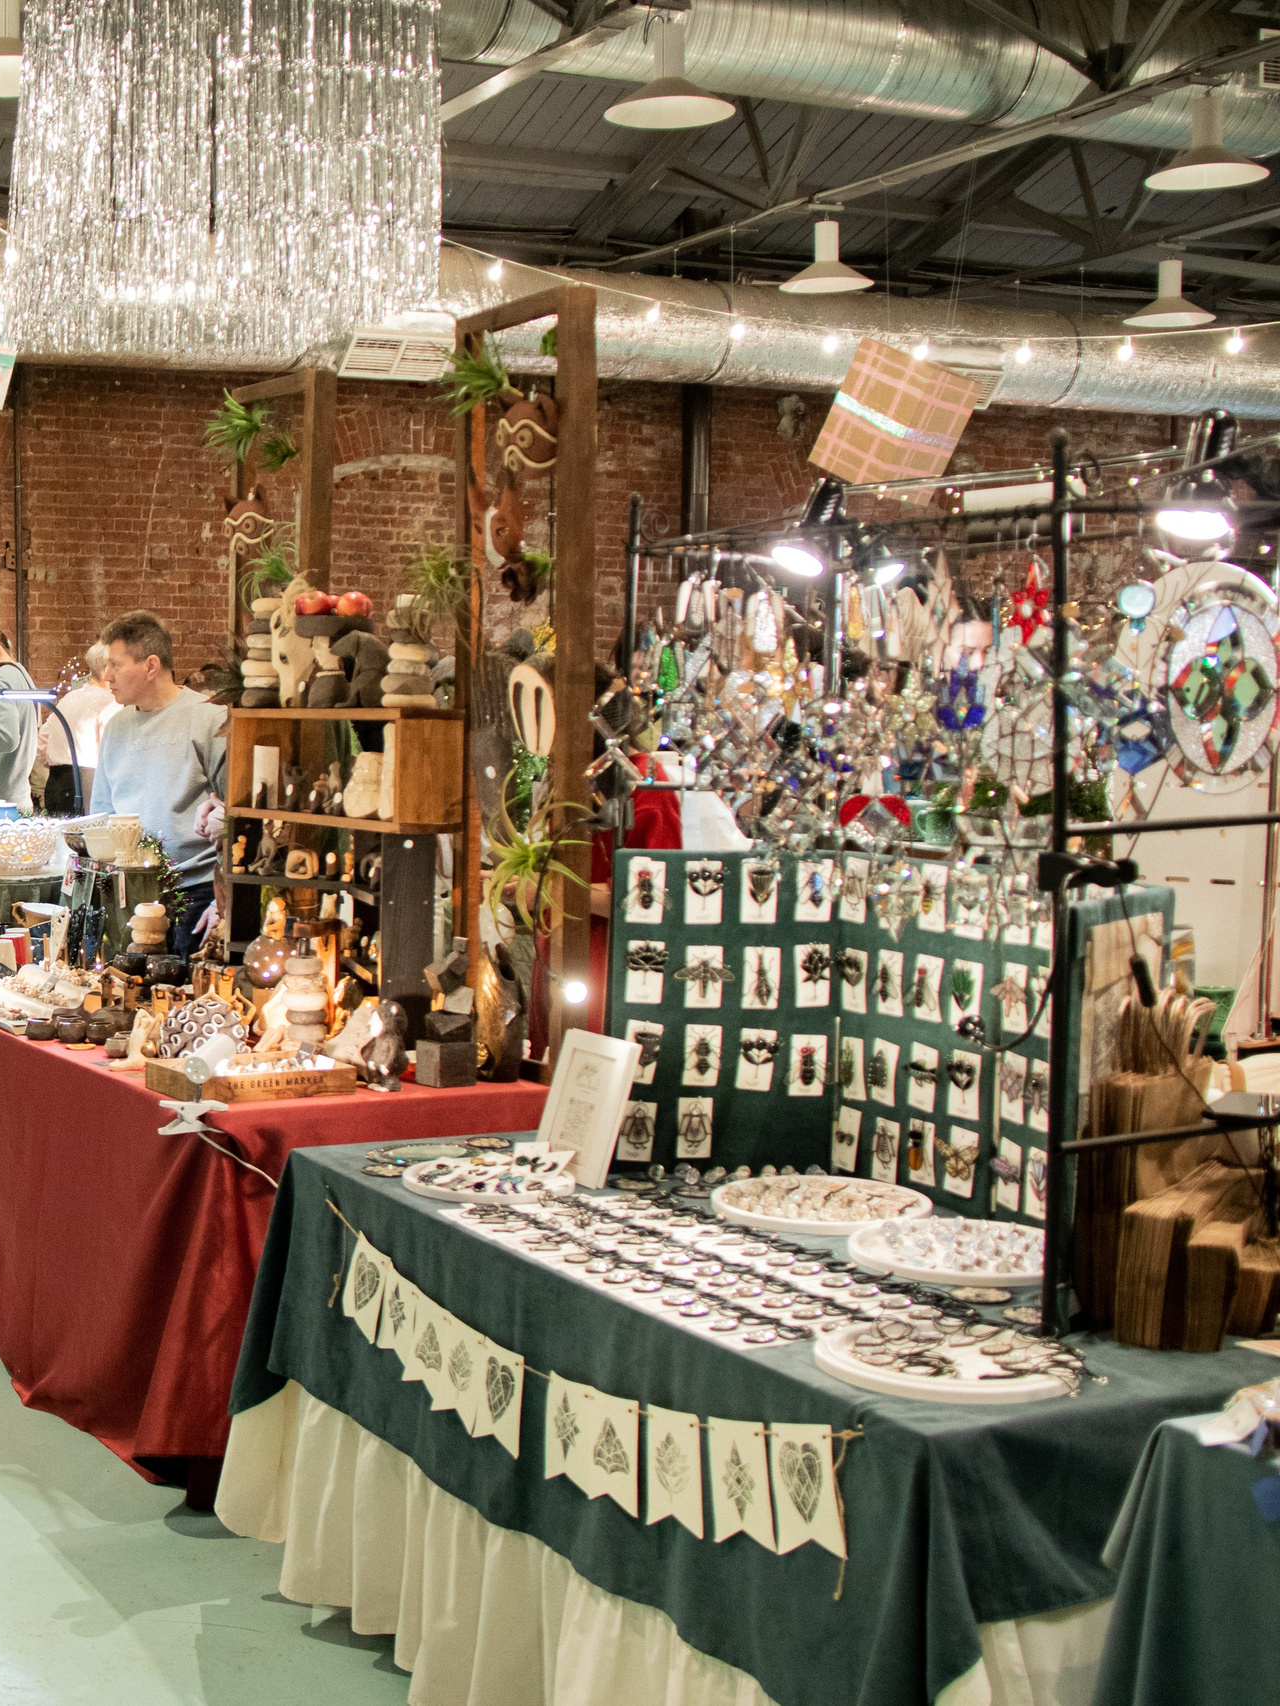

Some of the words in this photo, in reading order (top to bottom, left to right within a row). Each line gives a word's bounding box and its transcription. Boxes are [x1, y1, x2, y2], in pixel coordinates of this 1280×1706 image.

[227, 1081, 245, 1090] THE
[250, 1078, 280, 1089] GREEN
[285, 1075, 324, 1086] MARKET
